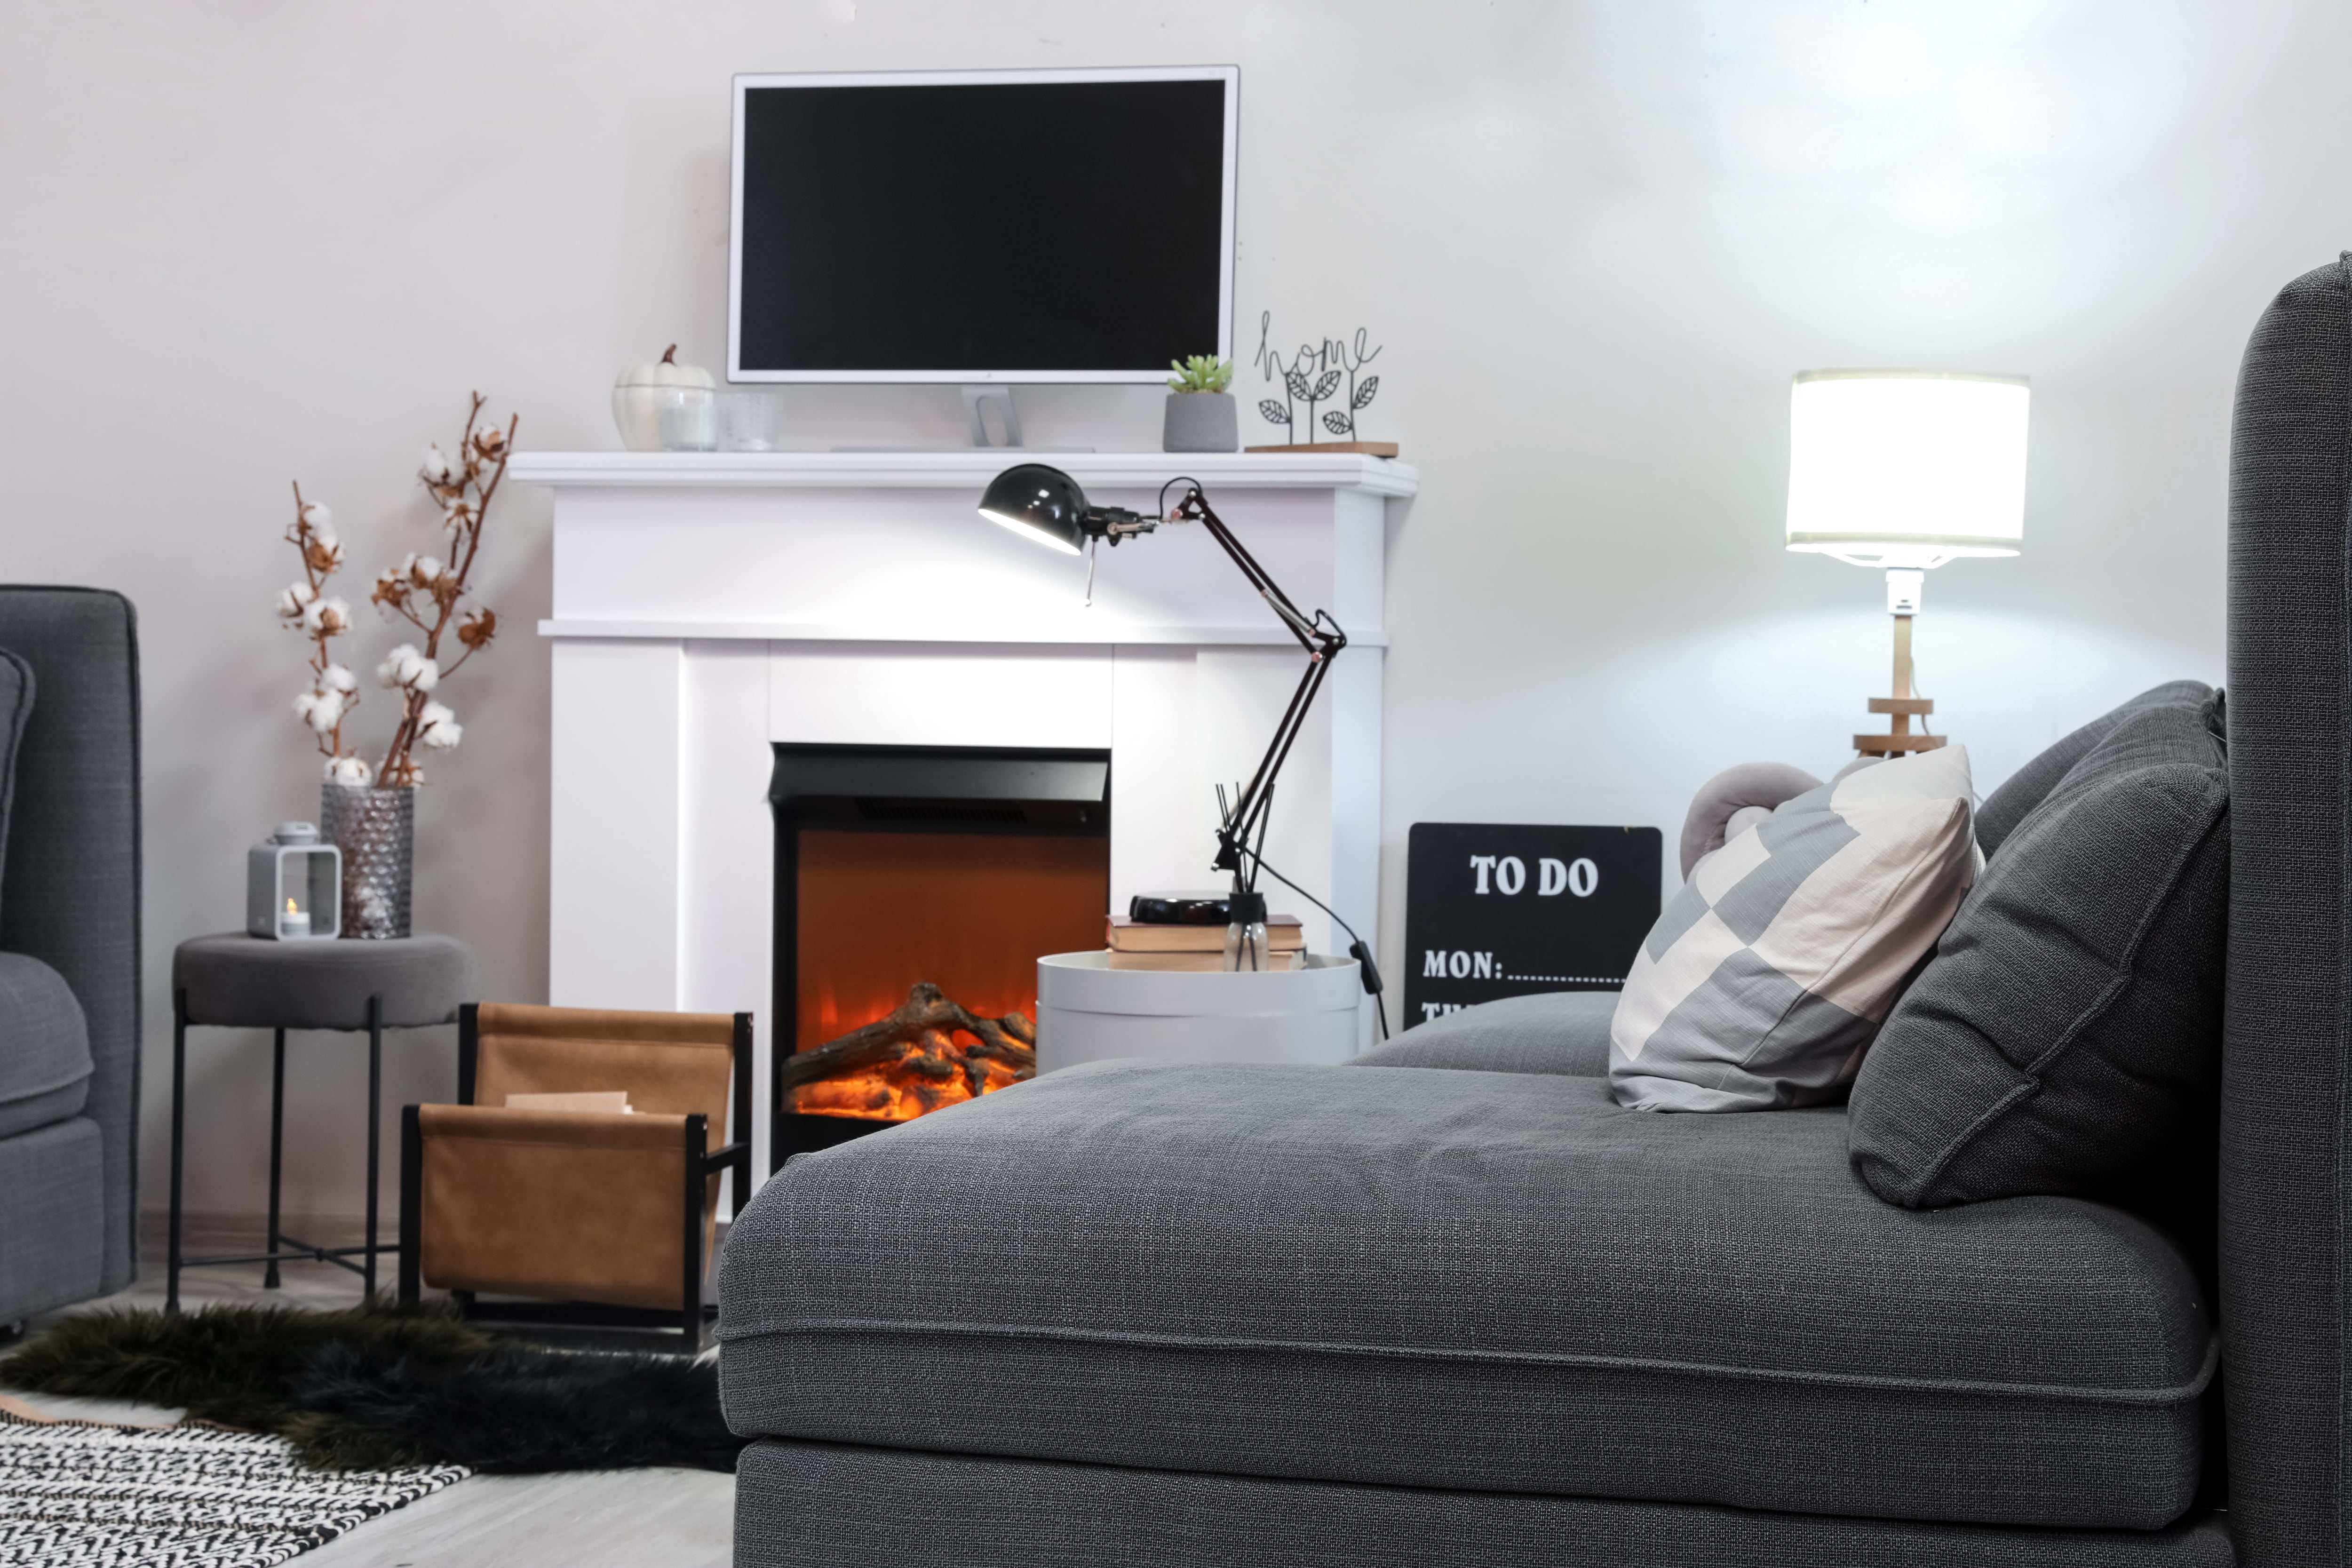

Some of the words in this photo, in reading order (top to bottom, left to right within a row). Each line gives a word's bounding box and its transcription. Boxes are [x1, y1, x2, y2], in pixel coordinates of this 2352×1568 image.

[1254, 310, 1383, 382] home
[1470, 855, 1526, 895] TO
[1538, 858, 1598, 897] DO
[1423, 950, 1502, 979] MON:
